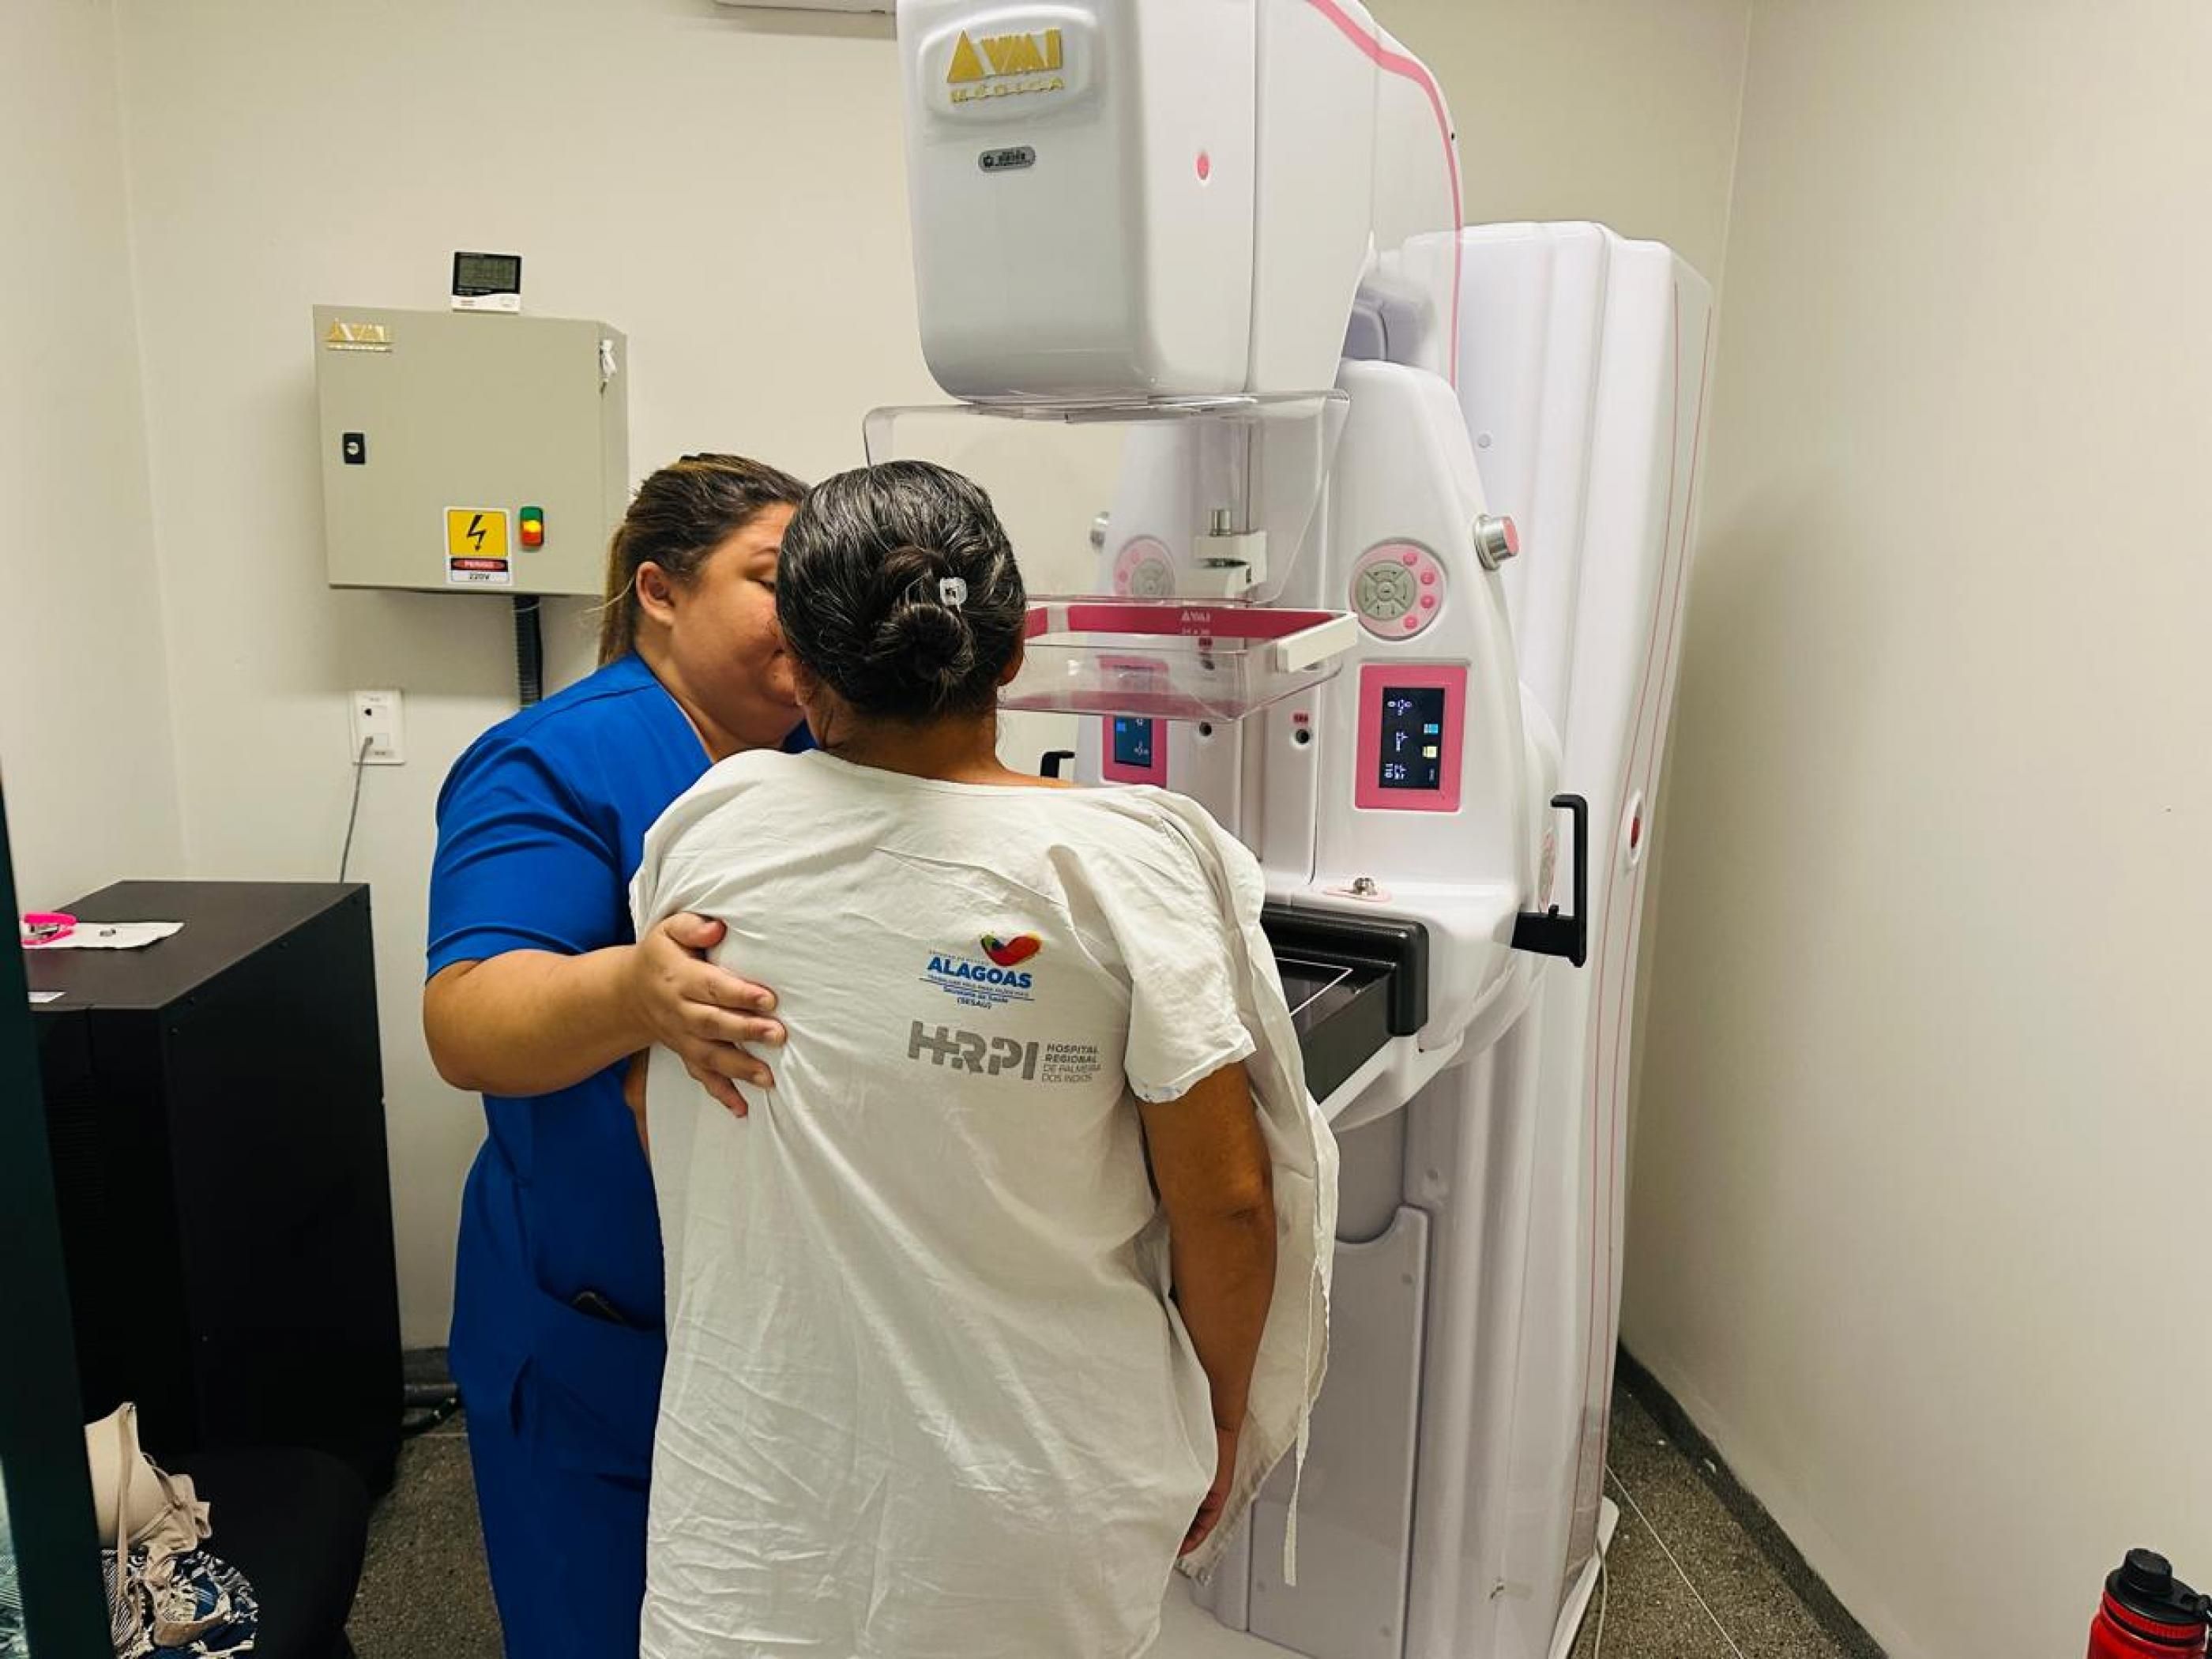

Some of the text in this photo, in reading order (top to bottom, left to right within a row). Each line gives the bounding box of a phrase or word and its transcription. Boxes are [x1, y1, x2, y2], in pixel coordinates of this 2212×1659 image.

[927, 956, 1033, 989] ALAGOAS
[907, 1020, 1040, 1081] HRPI
[1044, 1054, 1097, 1063] REGIONAL
[1047, 1043, 1099, 1054] HOSPITAL
